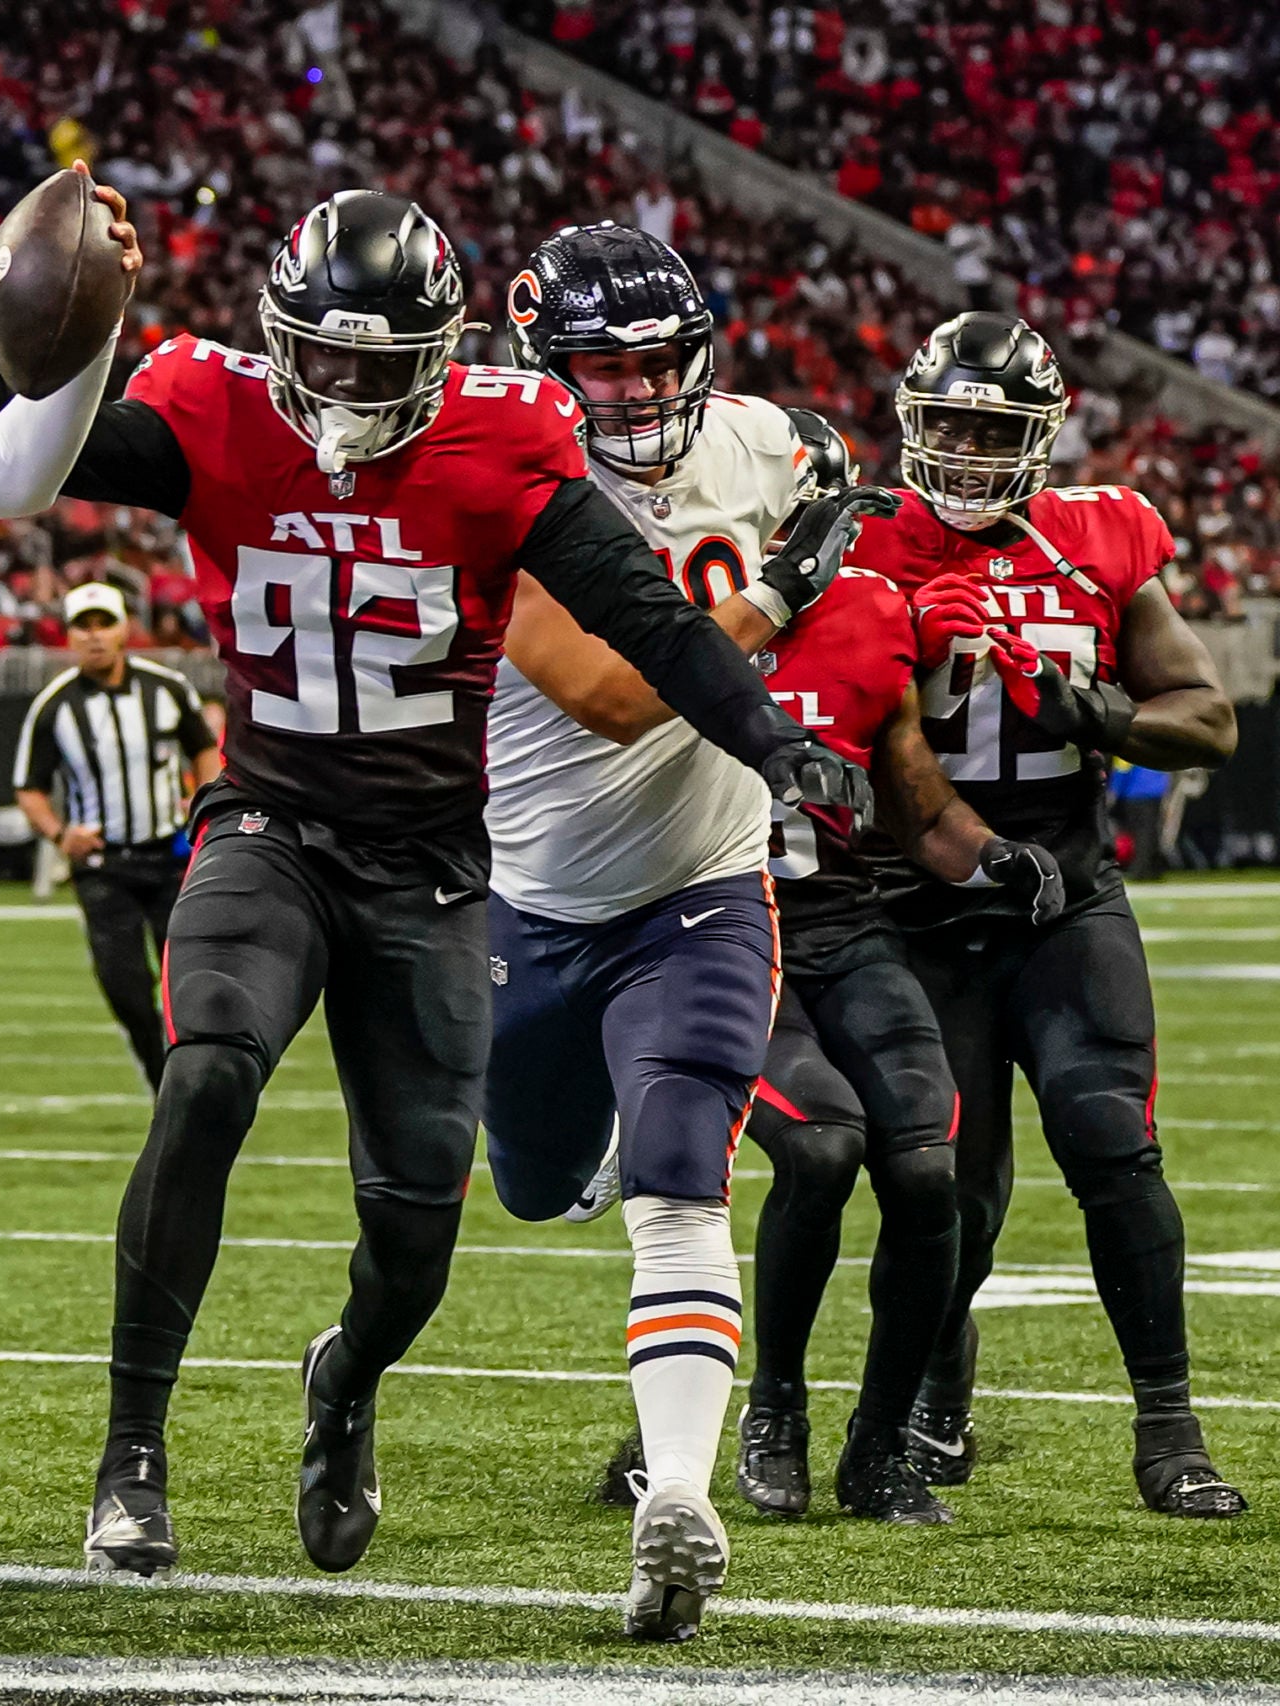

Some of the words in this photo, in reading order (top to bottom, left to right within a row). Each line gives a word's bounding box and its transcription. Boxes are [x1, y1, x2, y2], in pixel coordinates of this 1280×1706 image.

[508, 269, 543, 327] C
[338, 318, 375, 331] ATL
[963, 385, 991, 397] ATL
[267, 511, 422, 561] ATL
[230, 545, 458, 734] 92
